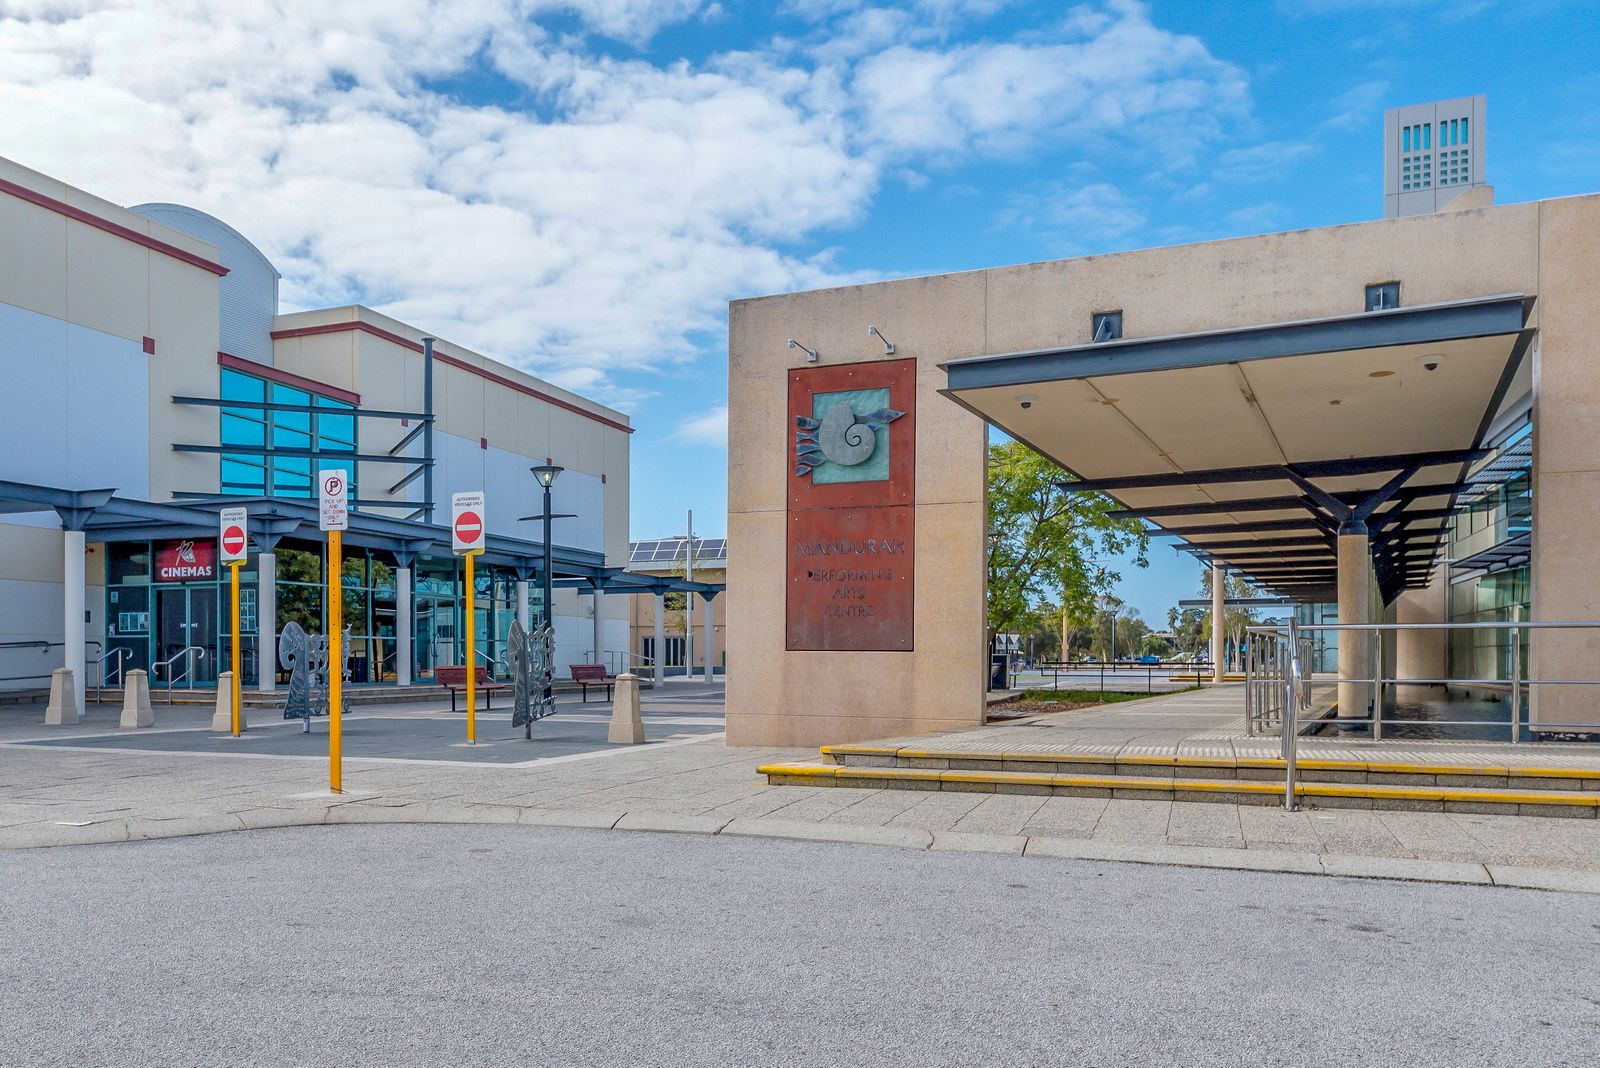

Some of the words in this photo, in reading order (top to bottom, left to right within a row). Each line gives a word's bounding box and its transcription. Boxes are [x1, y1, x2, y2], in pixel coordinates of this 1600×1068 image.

[796, 539, 905, 555] MANDURAH
[161, 566, 212, 577] CINEMAS
[807, 568, 893, 582] PERFORMING
[832, 586, 865, 600] ARTS
[824, 605, 875, 618] CENTRE
